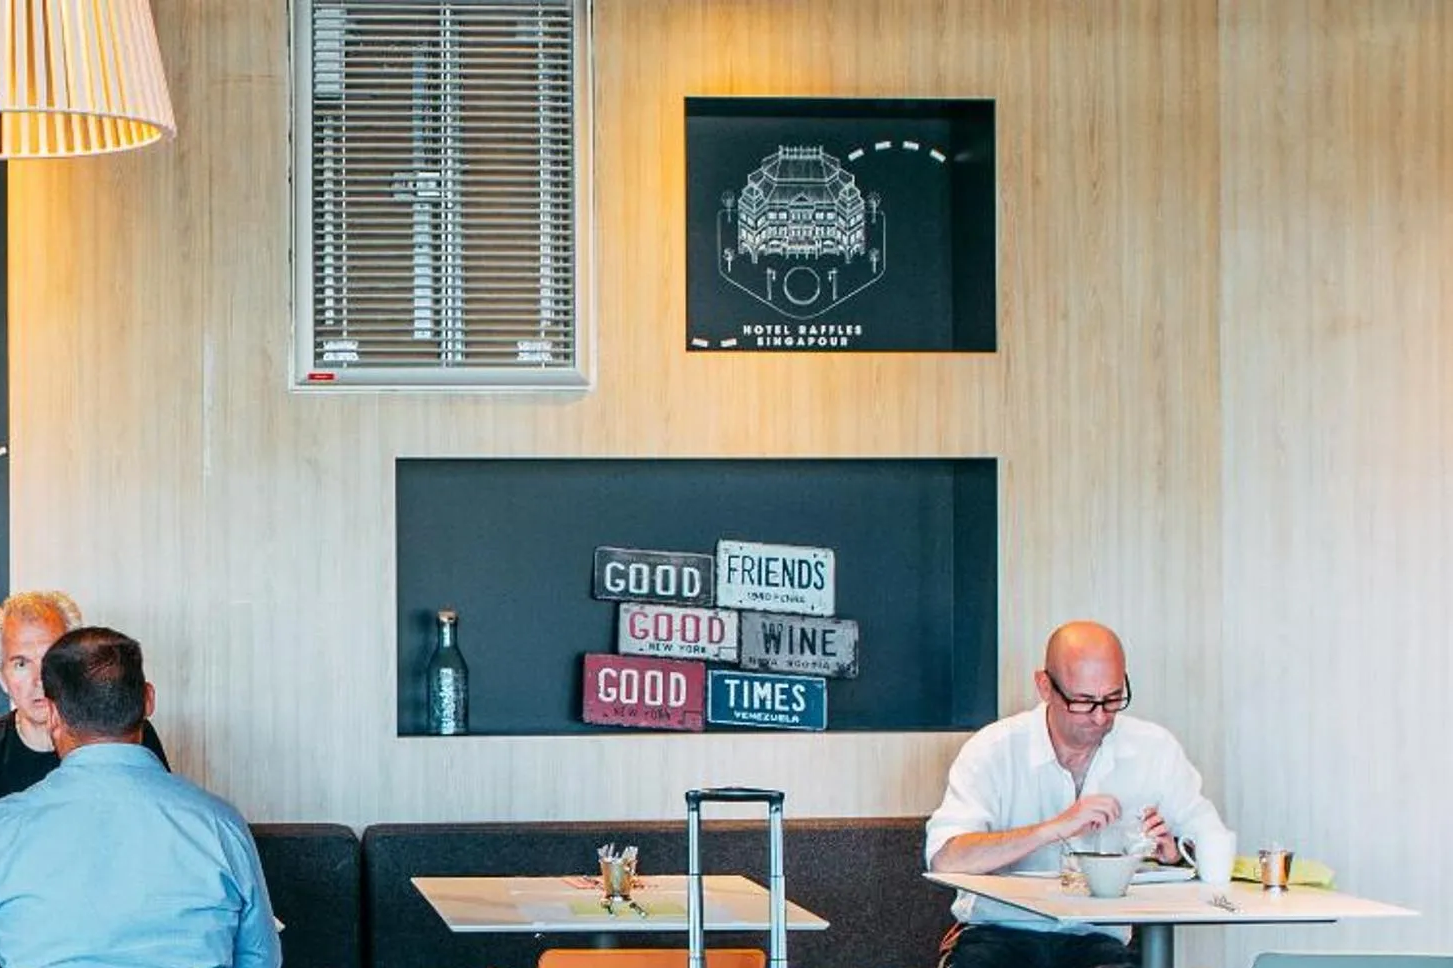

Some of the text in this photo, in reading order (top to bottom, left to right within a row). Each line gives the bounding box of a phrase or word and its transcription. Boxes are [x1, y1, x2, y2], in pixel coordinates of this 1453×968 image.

[743, 324, 863, 336] HOTEL RAFFLES
[756, 335, 848, 346] SINGAPOUR
[604, 561, 701, 598] GOOD
[727, 555, 826, 590] FRIENDS
[628, 611, 726, 645] GOOD
[761, 621, 838, 657] WINE
[649, 642, 674, 652] NEW
[598, 667, 687, 708] GOOD
[724, 678, 806, 712] TIMES
[733, 710, 800, 724] VENEZUELA
